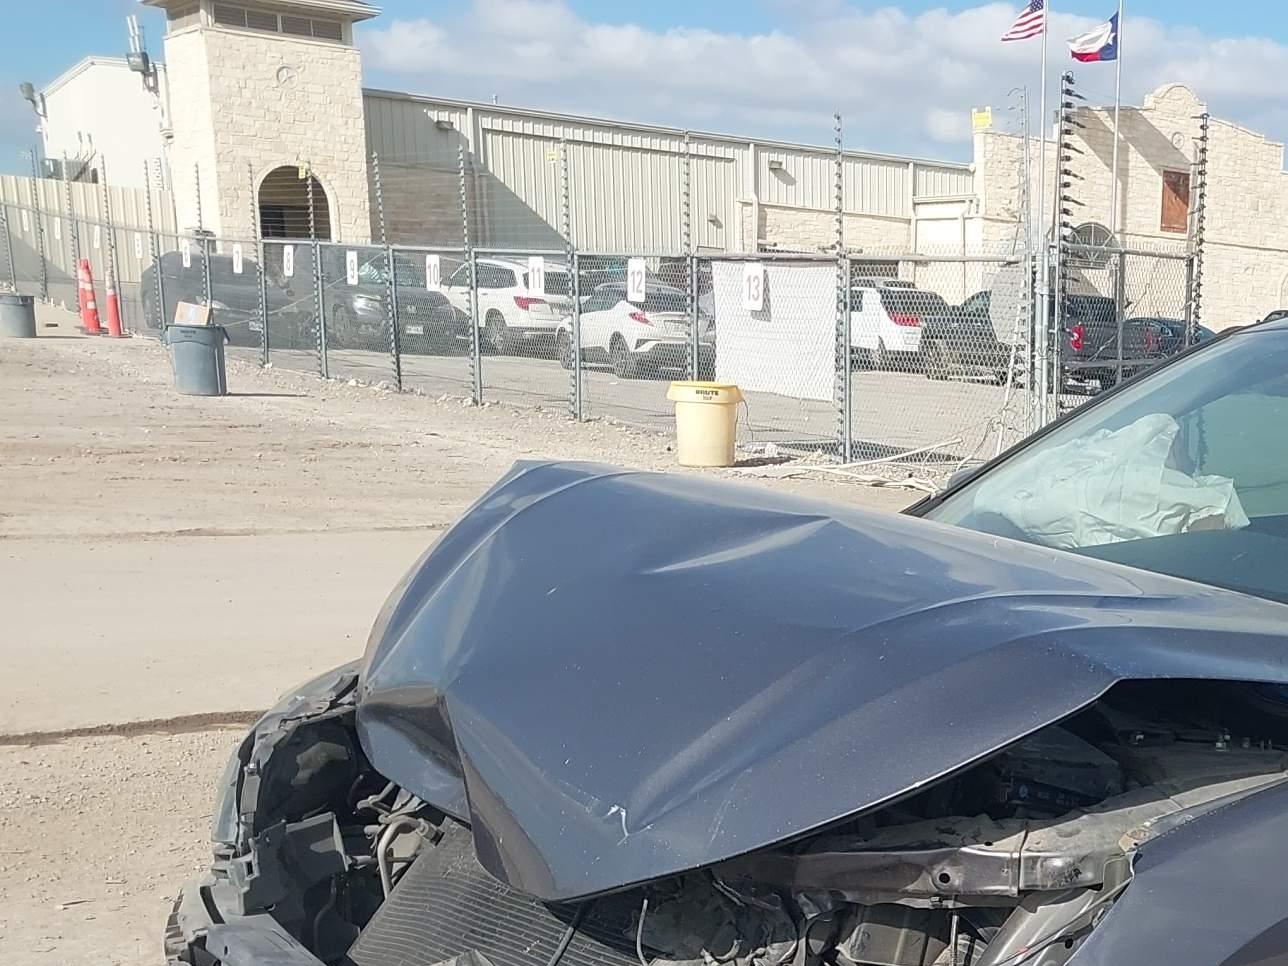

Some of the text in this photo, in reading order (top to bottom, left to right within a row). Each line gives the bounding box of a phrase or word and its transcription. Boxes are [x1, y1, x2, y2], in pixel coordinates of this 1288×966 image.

[349, 259, 356, 279] 9
[427, 264, 439, 284] 10
[531, 268, 542, 288] 11
[629, 271, 643, 293] 12
[746, 274, 760, 302] 13
